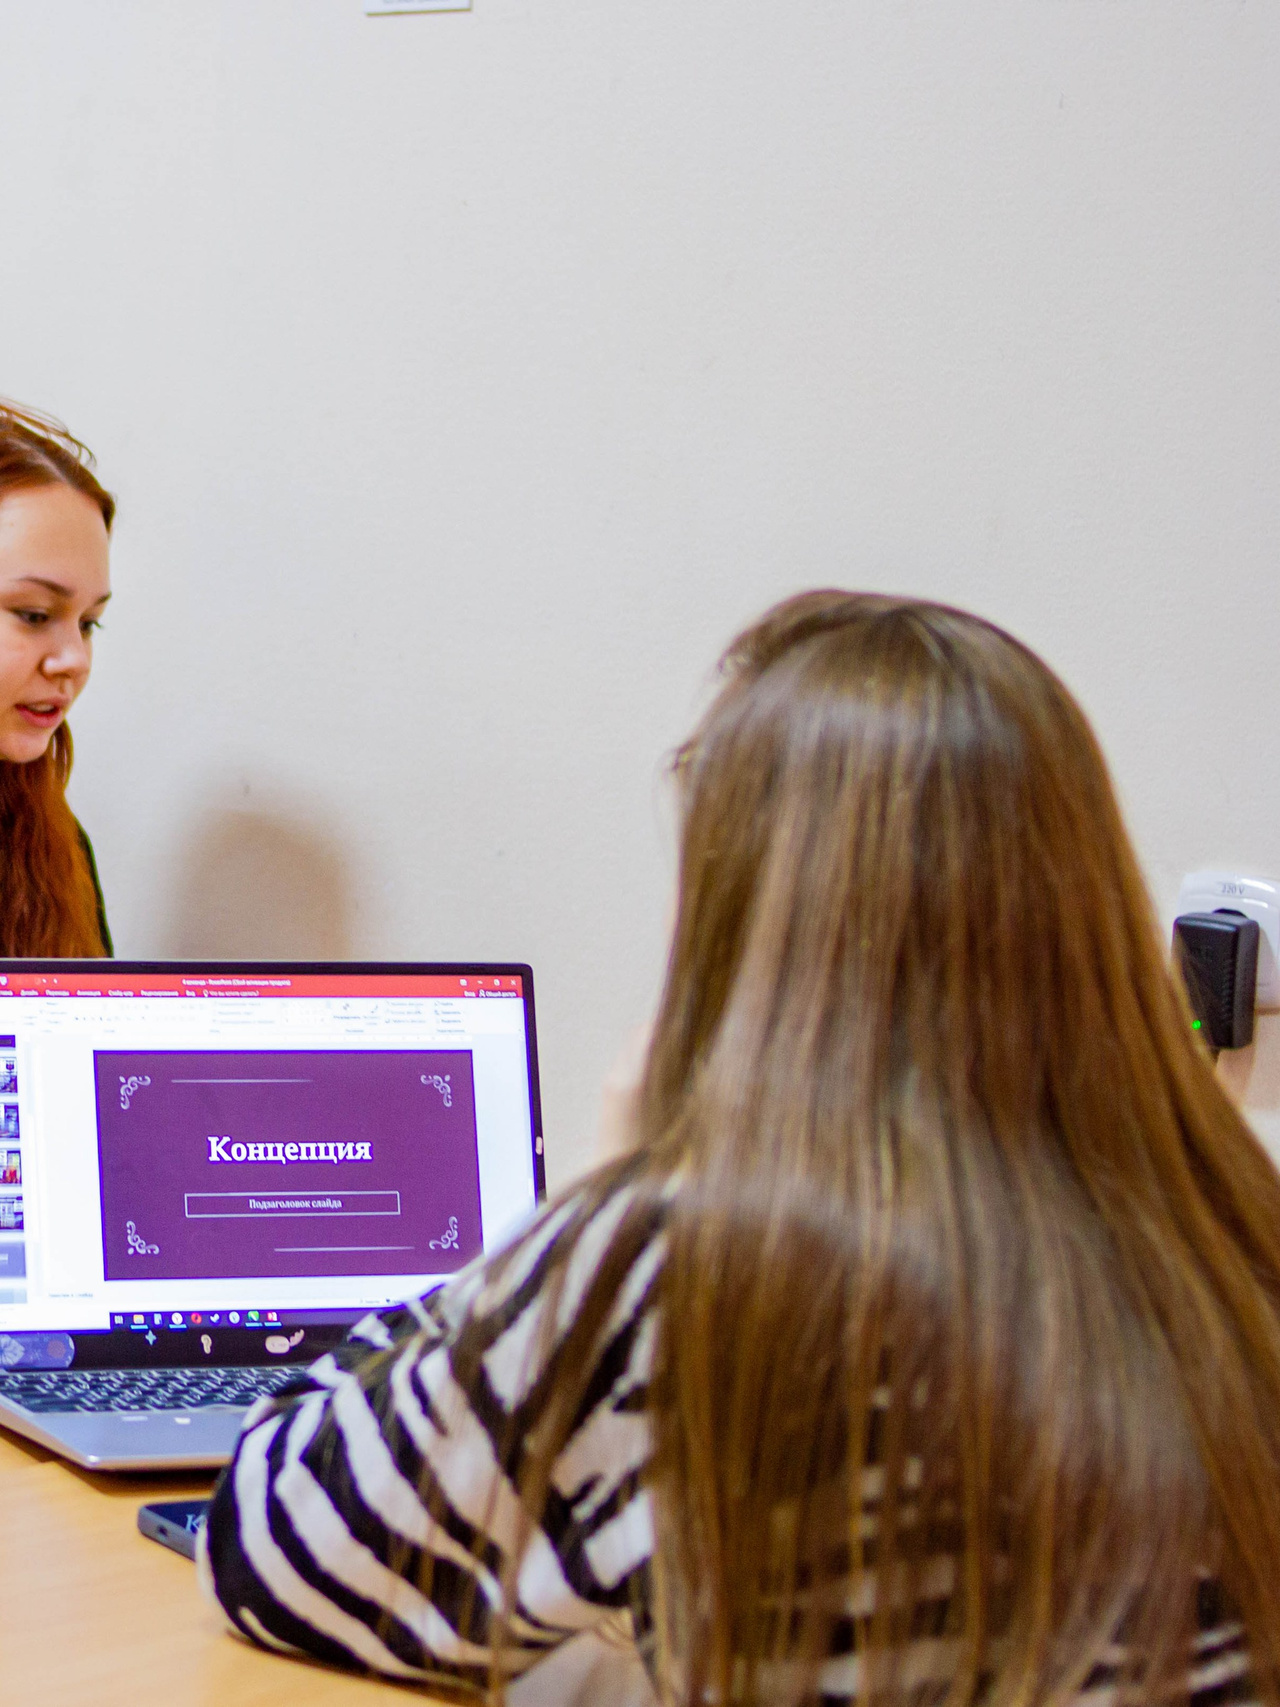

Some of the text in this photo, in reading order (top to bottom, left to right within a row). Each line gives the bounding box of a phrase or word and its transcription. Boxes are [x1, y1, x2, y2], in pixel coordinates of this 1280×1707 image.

[207, 1136, 372, 1164] Концепция
[249, 1199, 342, 1211] Подзаголовок слайда
